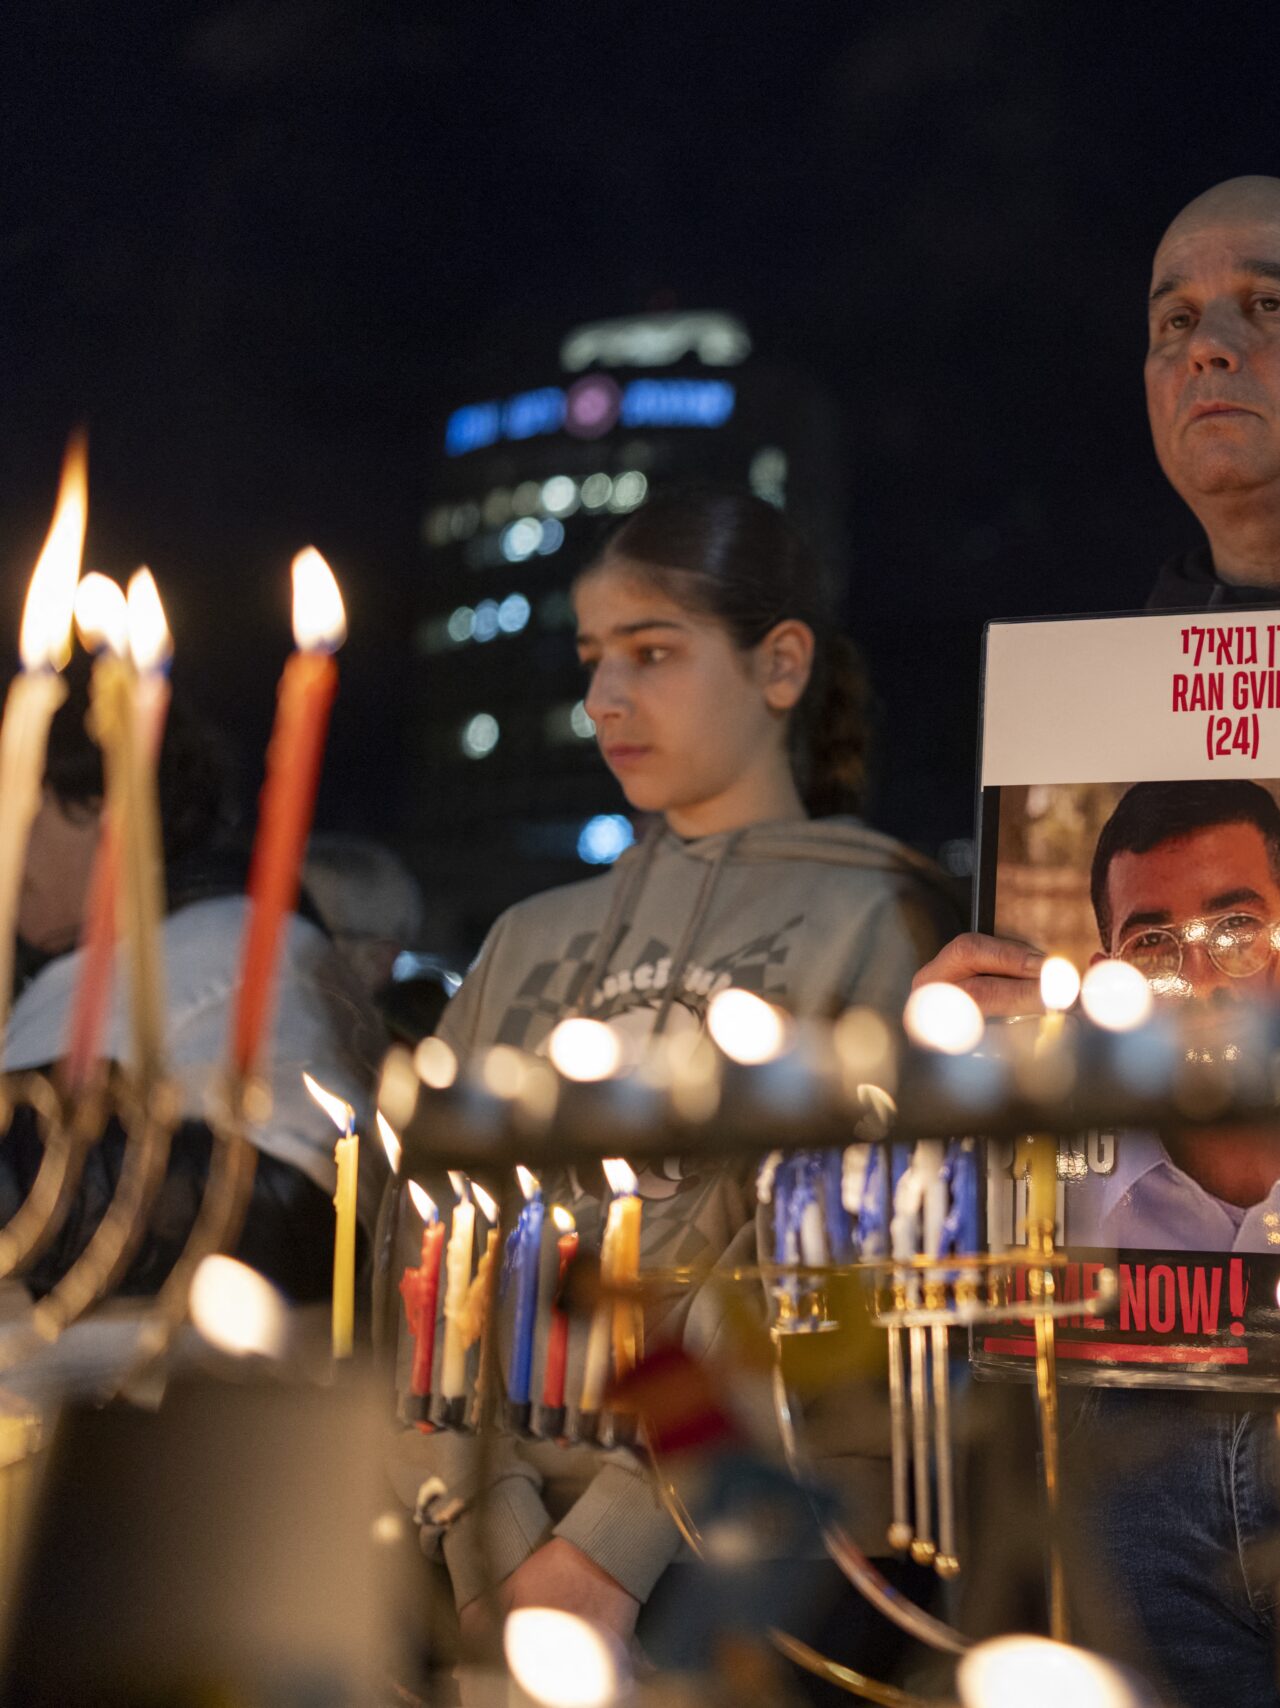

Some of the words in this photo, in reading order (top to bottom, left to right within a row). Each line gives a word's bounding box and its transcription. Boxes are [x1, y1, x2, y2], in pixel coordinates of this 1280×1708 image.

[1180, 625, 1257, 668] גואילי
[1172, 672, 1225, 713] RAN
[1206, 714, 1260, 761] (24)
[1119, 1257, 1249, 1338] NOW!
